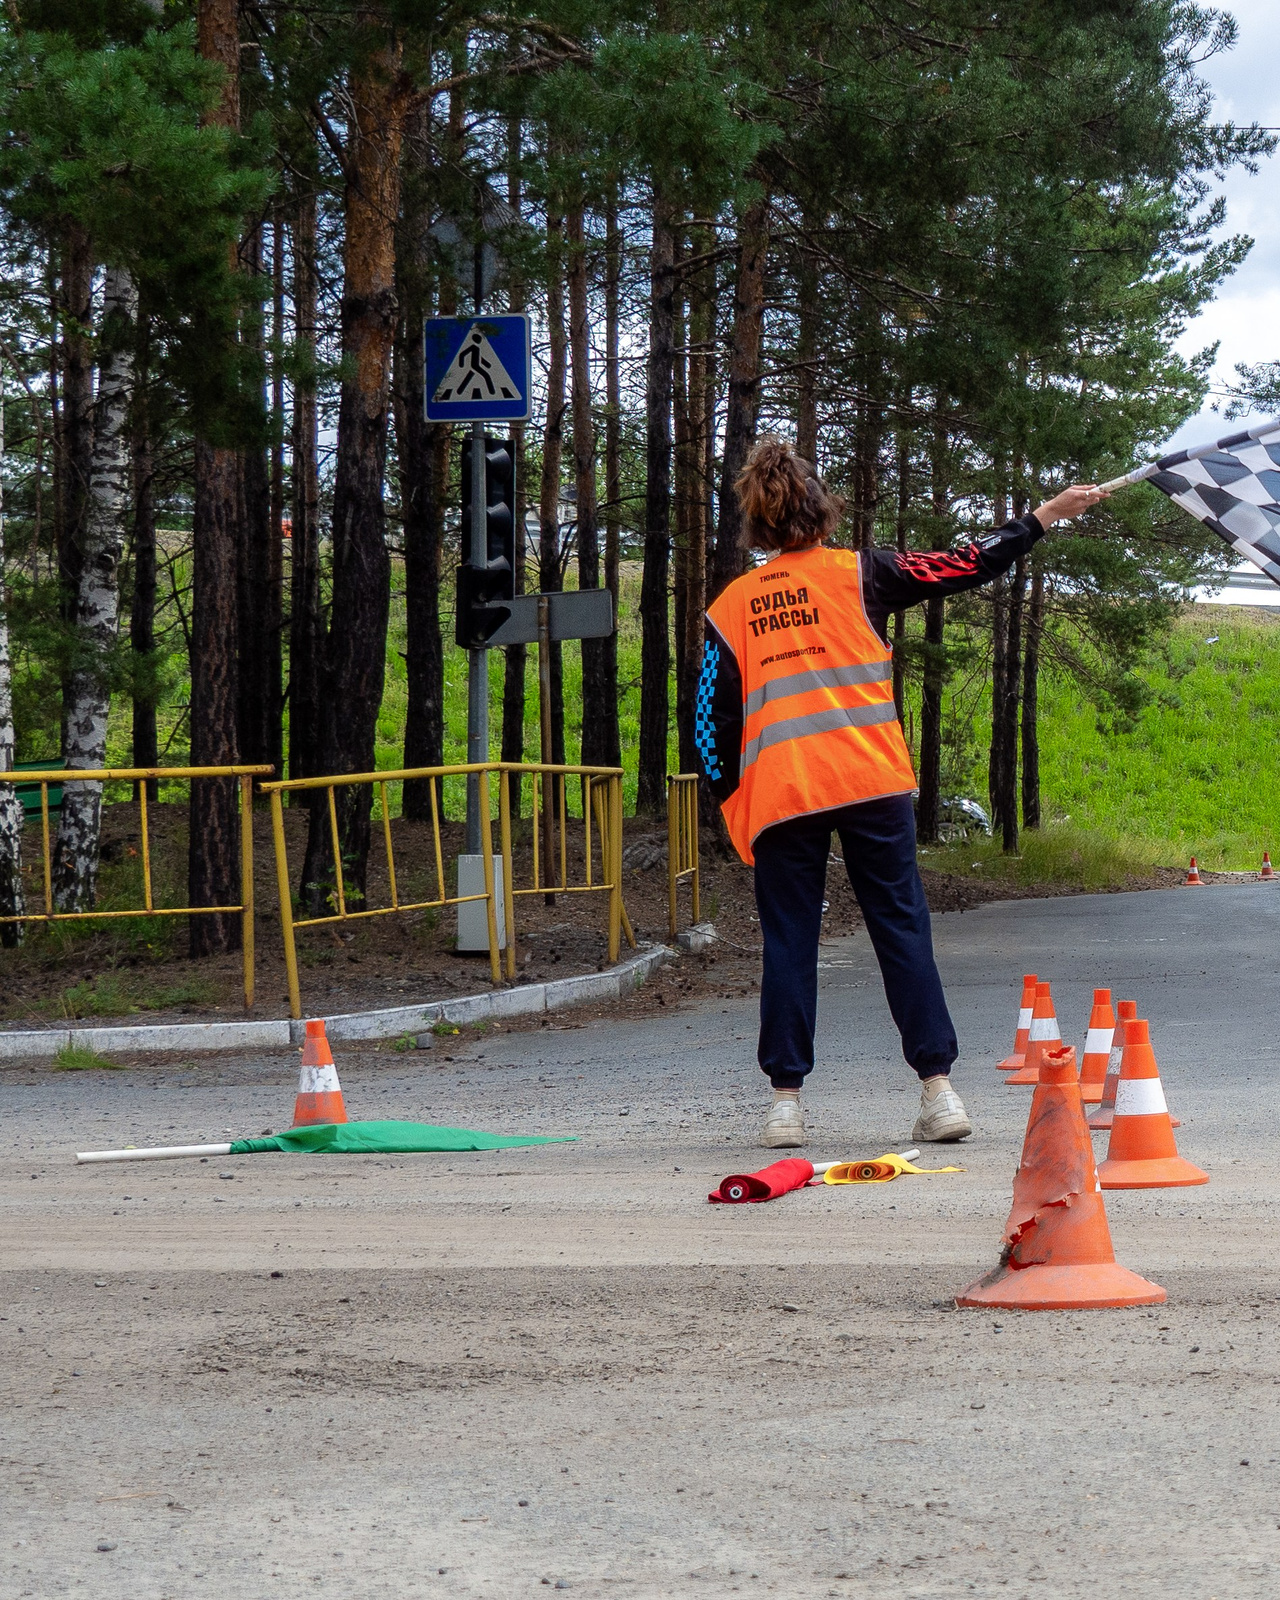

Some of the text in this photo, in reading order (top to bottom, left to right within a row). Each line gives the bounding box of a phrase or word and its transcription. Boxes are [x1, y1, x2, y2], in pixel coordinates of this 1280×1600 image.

[759, 571, 790, 583] ТЮМЕНЬ
[750, 587, 809, 615] СУДЬЯ
[748, 607, 820, 638] ТРАССЫ
